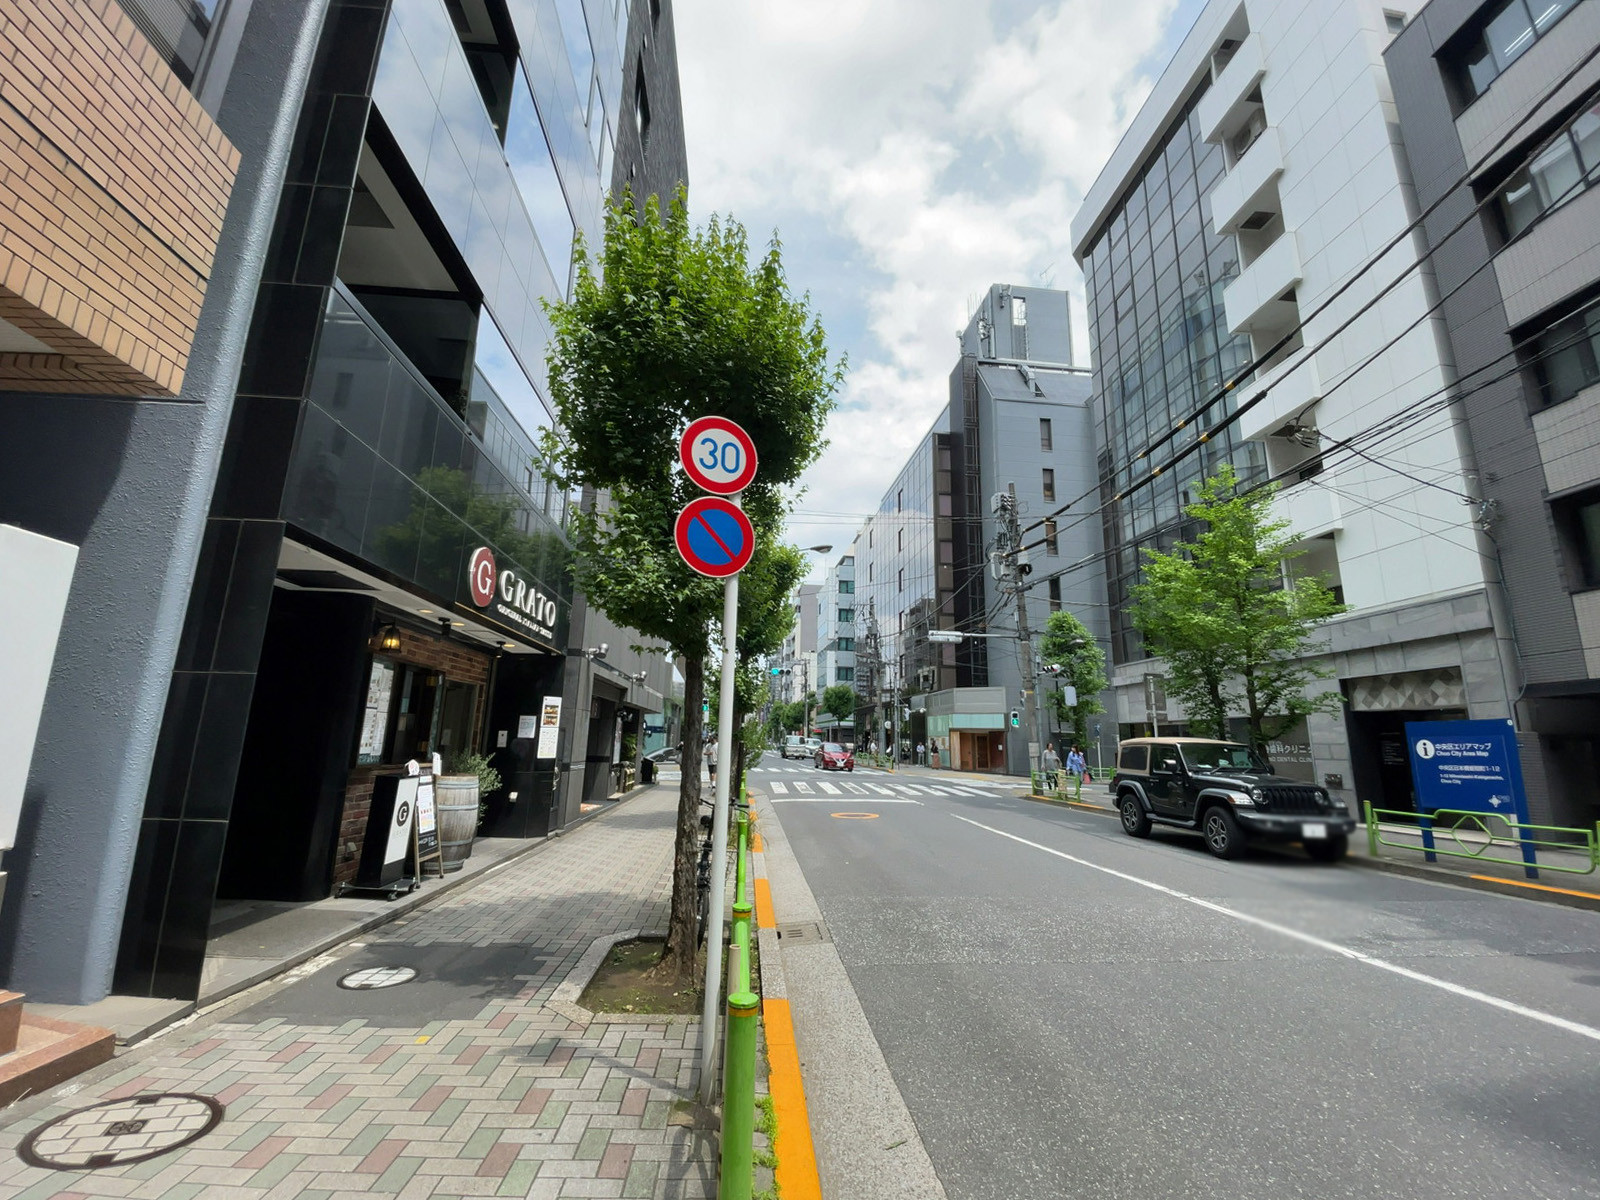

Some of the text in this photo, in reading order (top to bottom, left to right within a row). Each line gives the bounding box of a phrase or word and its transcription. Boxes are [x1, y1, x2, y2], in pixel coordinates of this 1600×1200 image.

[699, 437, 740, 474] 30
[477, 560, 492, 595] G
[499, 570, 556, 627] GRATO
[398, 806, 407, 821] G
